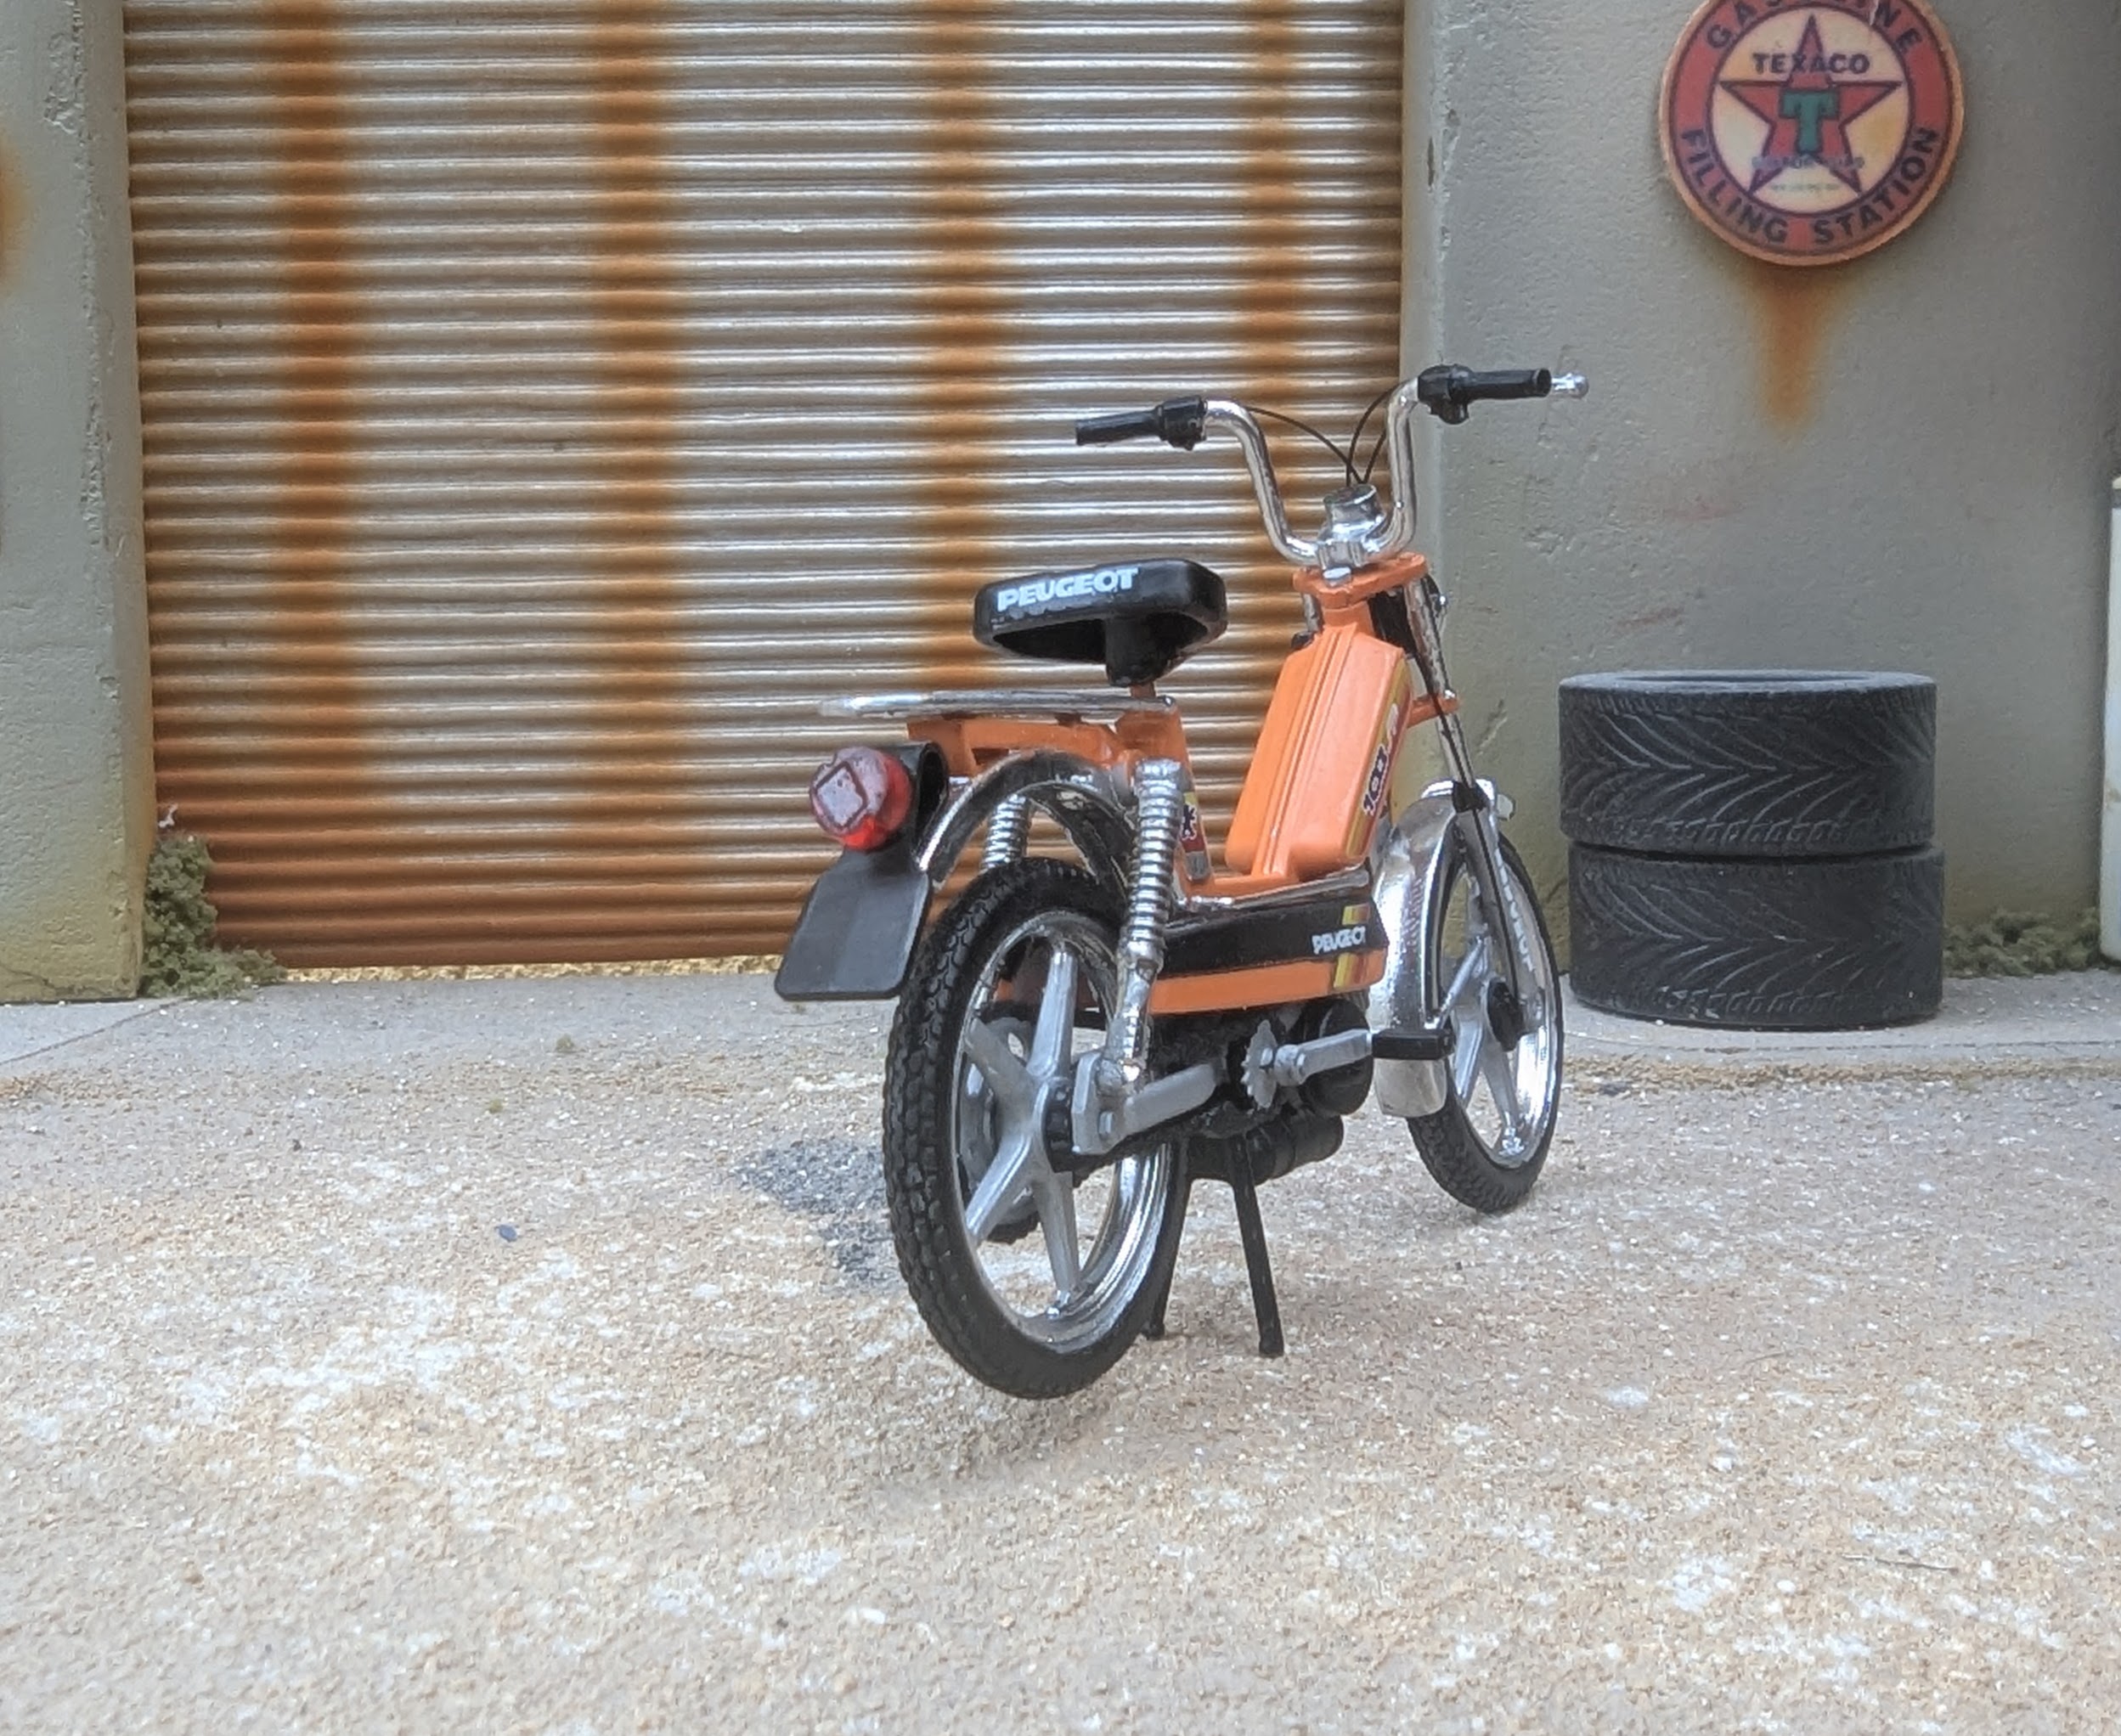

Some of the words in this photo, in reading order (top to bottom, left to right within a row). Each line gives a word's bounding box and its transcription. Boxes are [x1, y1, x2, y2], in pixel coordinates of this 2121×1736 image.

[1706, 0, 1922, 54] GANE
[1752, 53, 1870, 75] TEXACO
[1779, 89, 1841, 155] T
[1681, 128, 1789, 245] FILLING
[1813, 128, 1938, 245] STATION
[996, 566, 1139, 612] PEUGEOT
